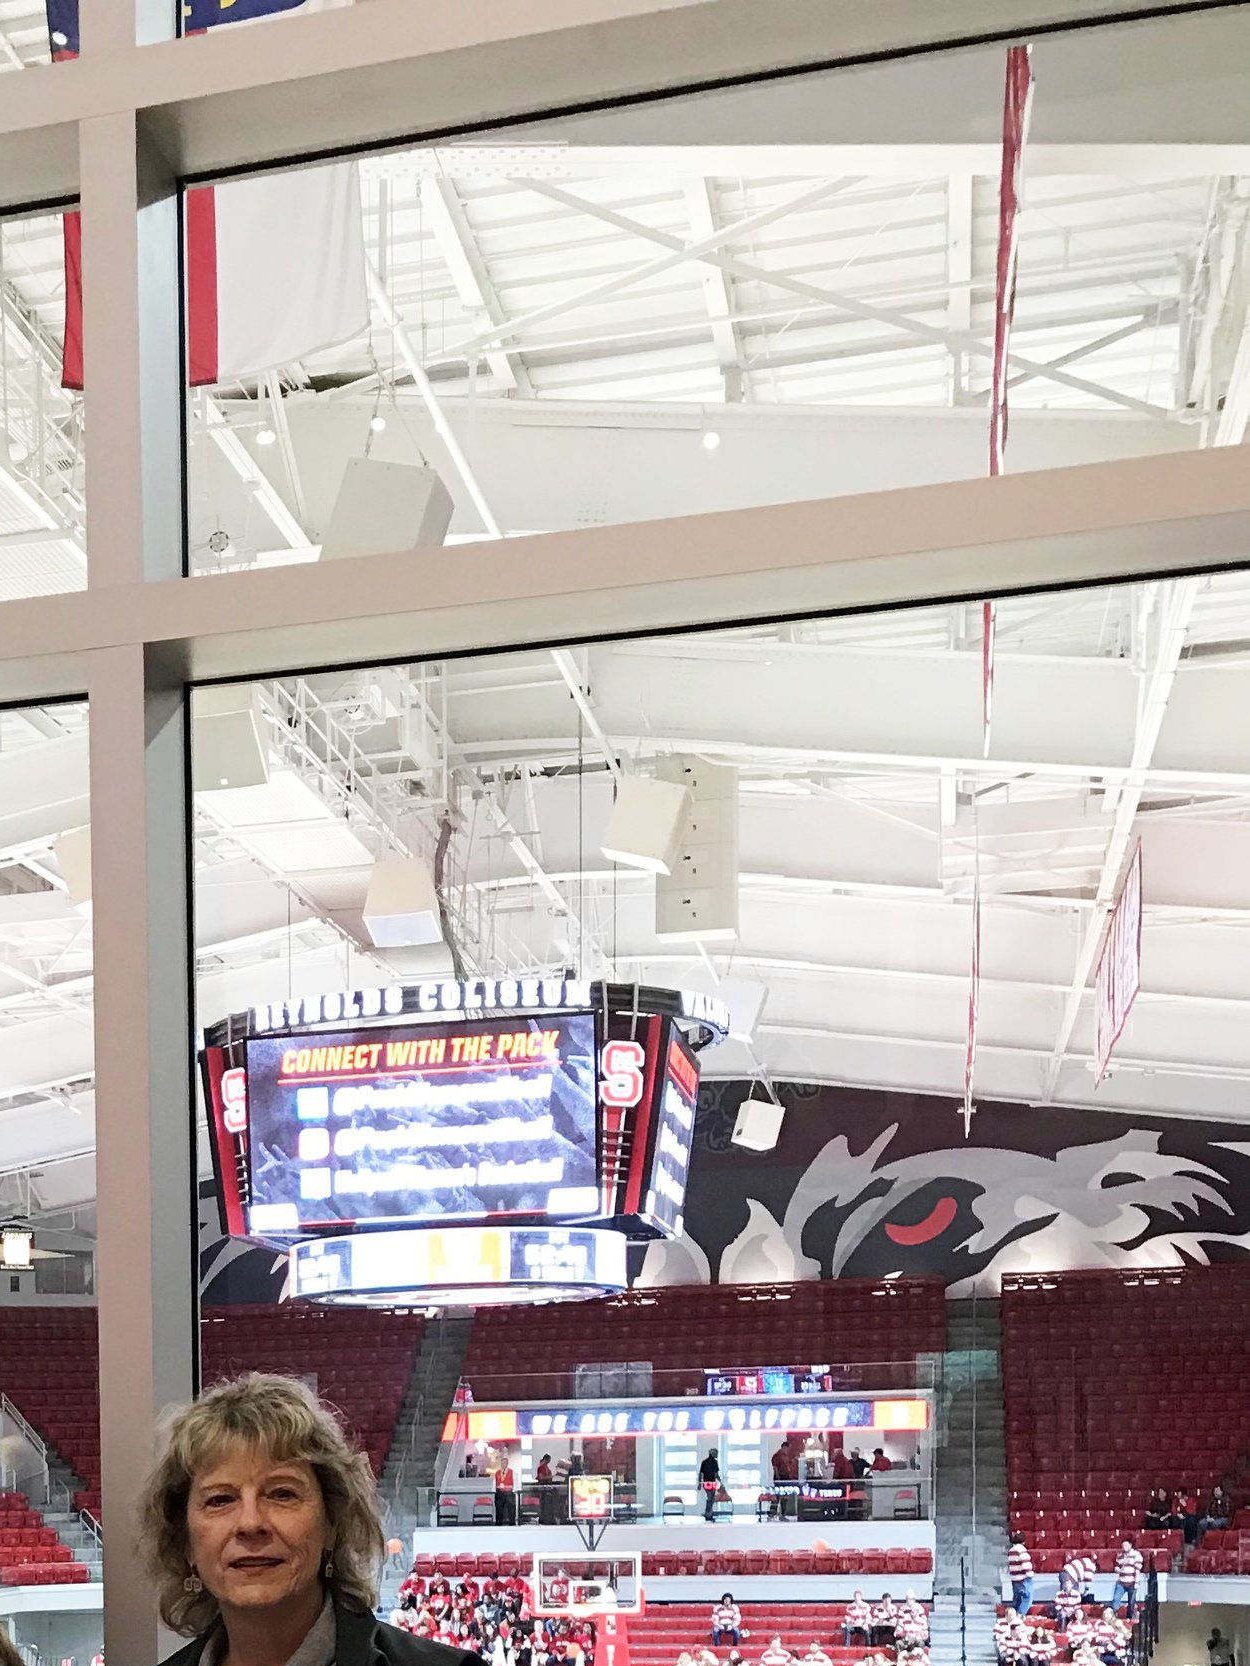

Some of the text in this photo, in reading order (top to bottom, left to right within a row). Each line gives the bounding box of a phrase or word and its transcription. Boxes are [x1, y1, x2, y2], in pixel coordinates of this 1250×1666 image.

[255, 977, 593, 1032] REYNOLDS COLISEUM
[281, 1030, 561, 1075] CONNECT WITH THE PACK
